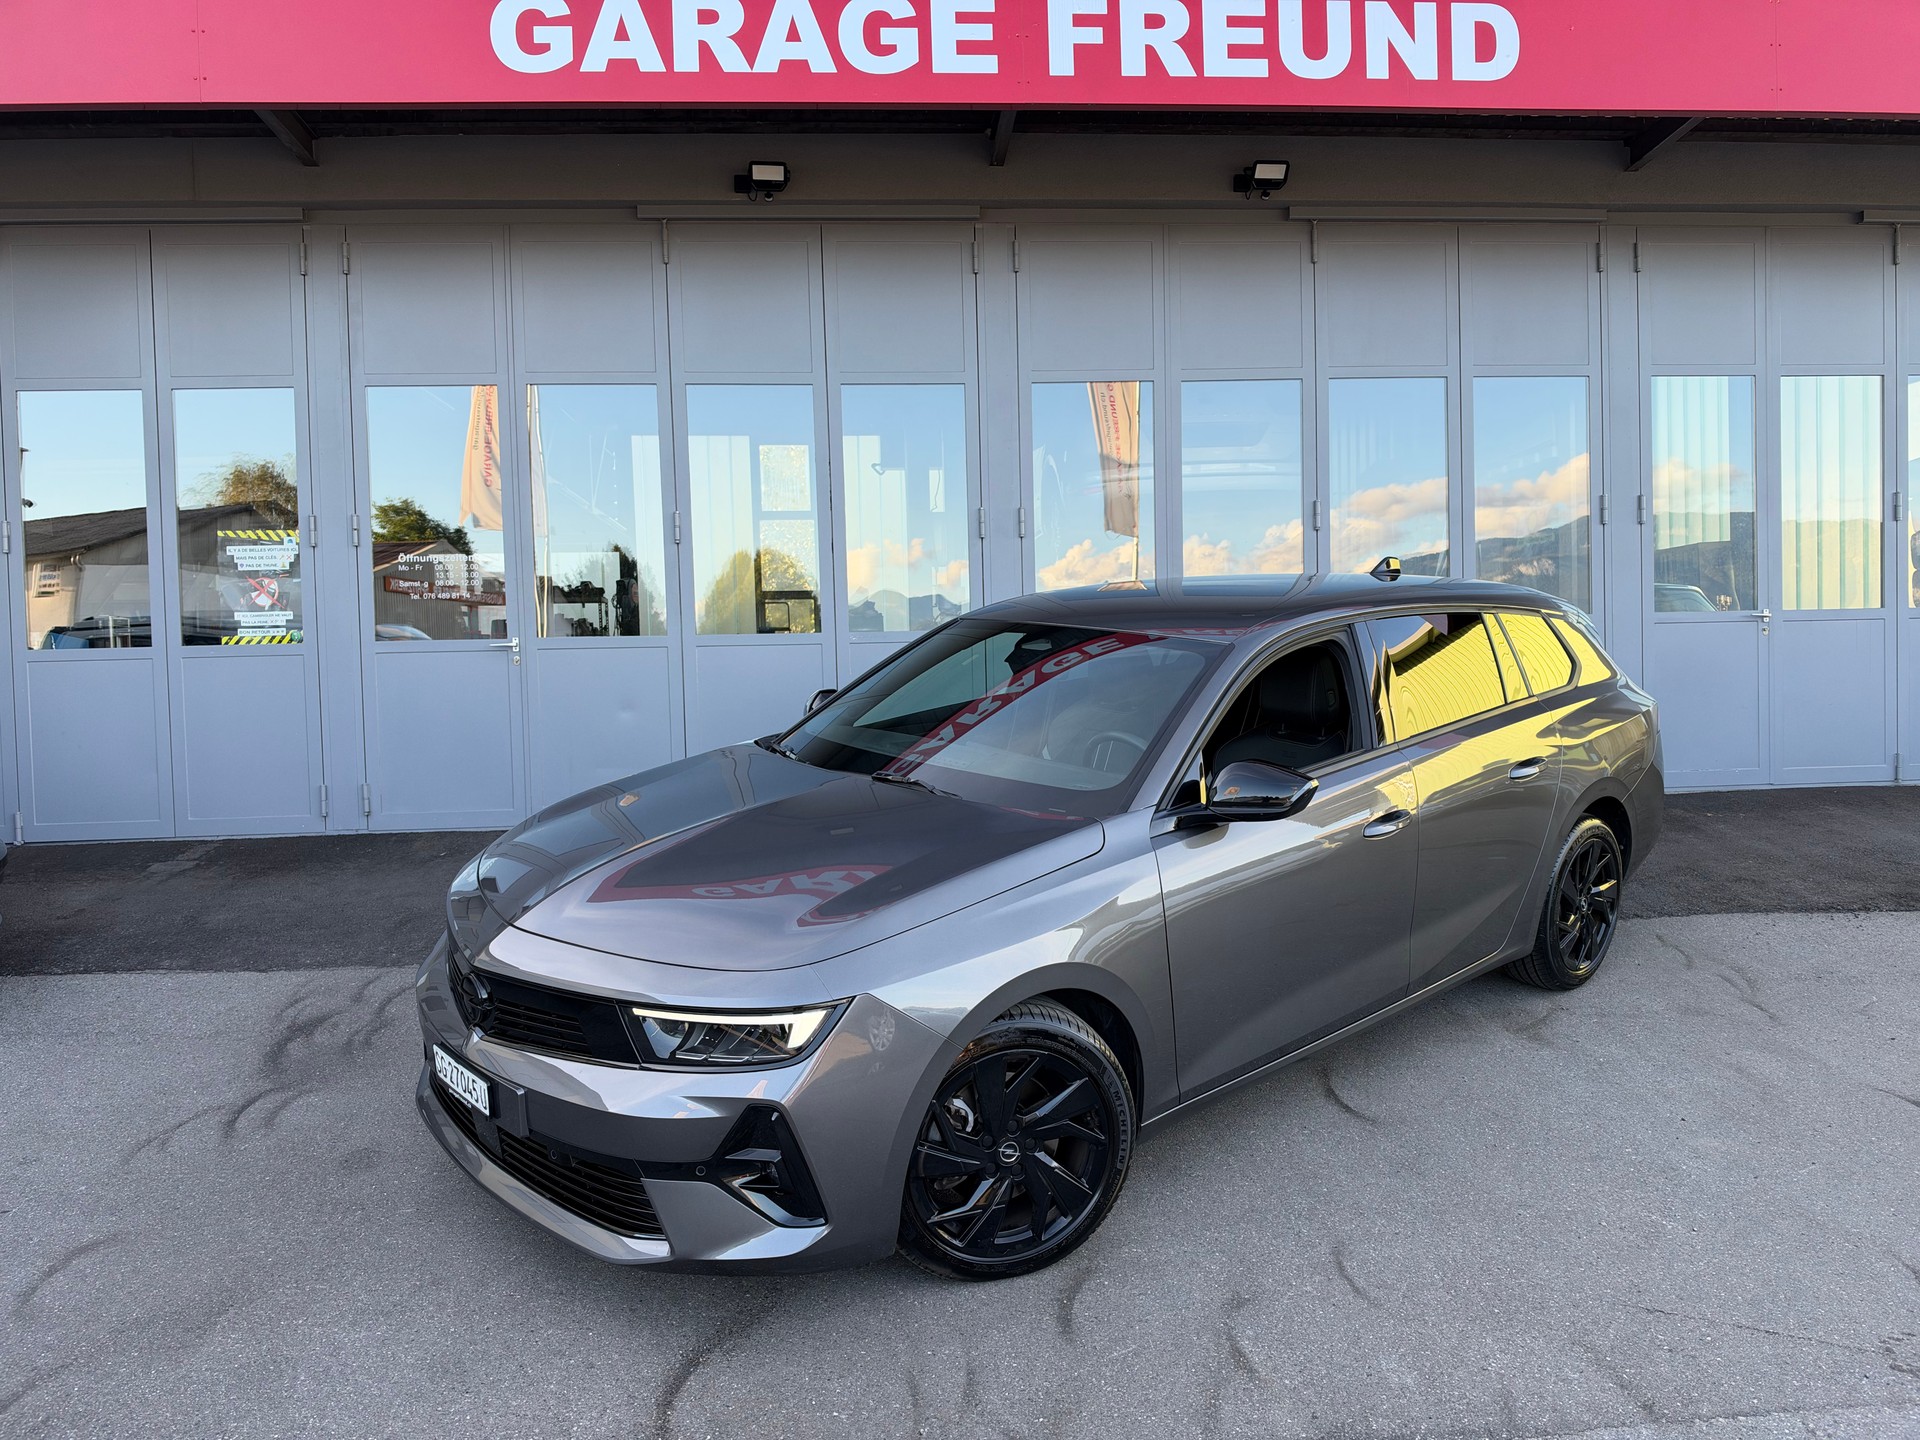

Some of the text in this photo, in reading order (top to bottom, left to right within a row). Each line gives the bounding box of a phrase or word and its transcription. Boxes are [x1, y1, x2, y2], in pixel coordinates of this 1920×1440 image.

[489, 0, 1521, 82] GARAGE FREUND
[1112, 1090, 1126, 1165] MICHELIN
